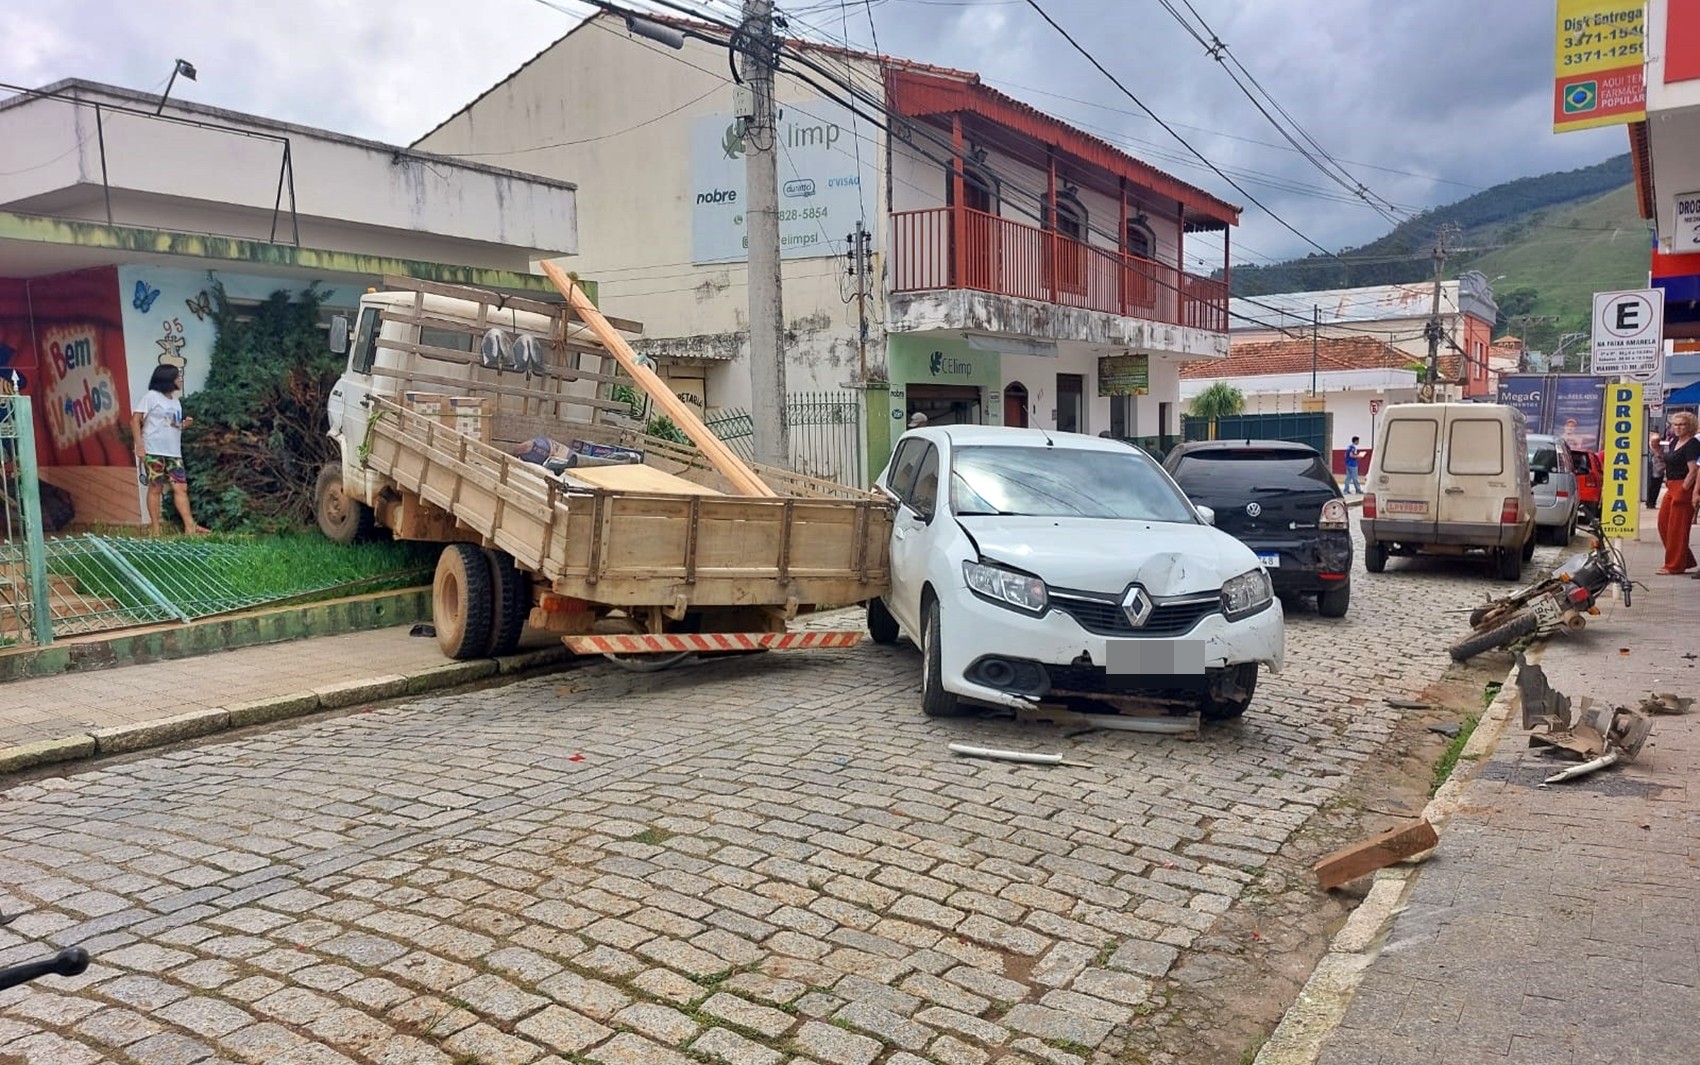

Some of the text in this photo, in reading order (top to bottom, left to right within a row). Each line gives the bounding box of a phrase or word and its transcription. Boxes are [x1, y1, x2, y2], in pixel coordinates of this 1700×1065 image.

[1594, 8, 1643, 27] Entrega
[1602, 77, 1625, 89] AQUI
[1601, 94, 1646, 108] POPULAR
[788, 122, 840, 150] limp
[696, 188, 737, 205] nobre
[778, 206, 828, 222] 828-5854
[781, 233, 818, 246] elimpsl
[1616, 302, 1639, 330] E
[50, 336, 92, 382] Bem
[1611, 388, 1632, 513] DROGARIA
